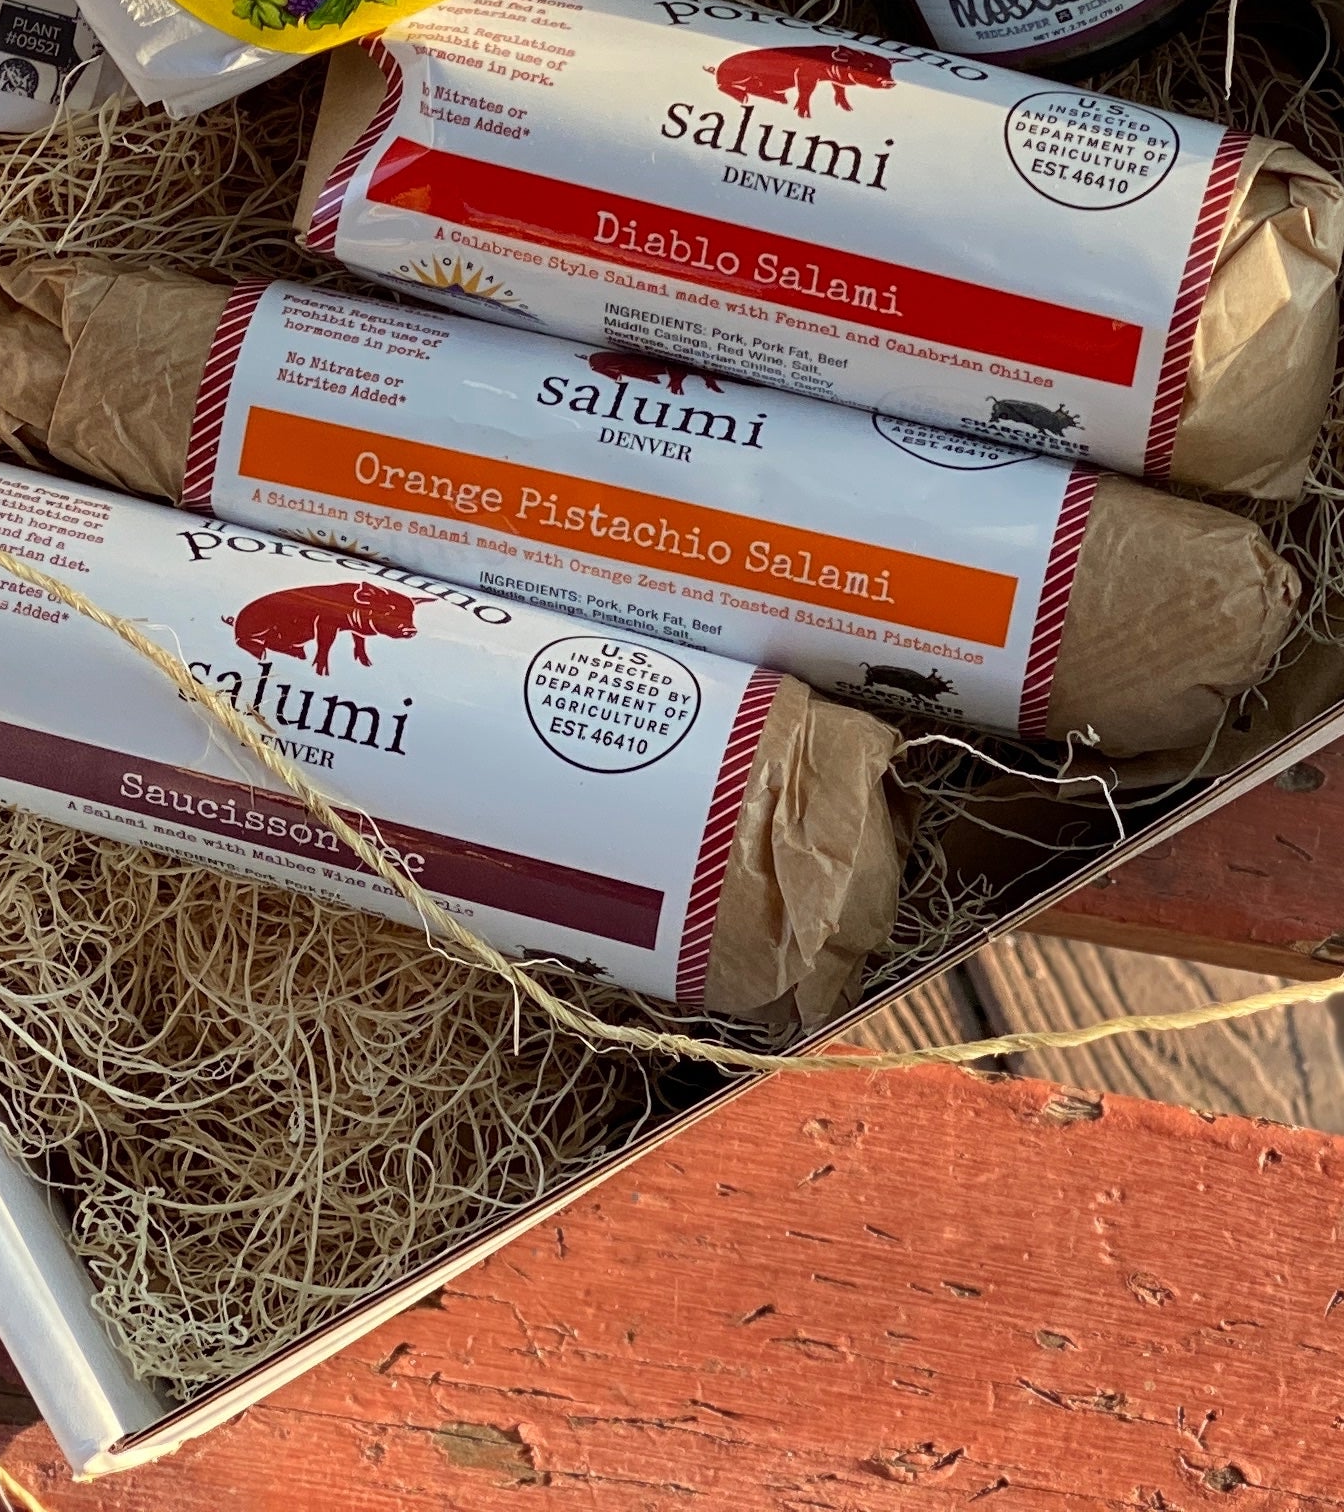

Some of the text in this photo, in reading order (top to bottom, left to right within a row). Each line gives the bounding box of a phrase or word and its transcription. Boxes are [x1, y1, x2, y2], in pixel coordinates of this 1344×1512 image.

[6, 32, 60, 57] #09521
[13, 16, 62, 39] PLANT
[474, 27, 577, 57] Regulations
[407, 32, 542, 65] prohibit the use
[511, 68, 555, 87] pork.
[435, 85, 504, 115] Nitrates
[507, 105, 528, 120] or
[1049, 104, 1151, 132] INSPECTED
[660, 100, 896, 191] salumi
[1015, 121, 1168, 163] DEPARTMENT OF
[1021, 110, 1170, 148] AND PASSED BY
[1022, 138, 1150, 177] AGRICULTURE
[1031, 158, 1129, 194] EST. 46410
[721, 164, 817, 205] DENVER
[593, 210, 904, 318] Diablo Salami
[281, 305, 443, 349] prohibit the use of
[283, 293, 345, 314] Federal
[349, 309, 451, 339] Regulations
[451, 230, 1055, 388] Calabrese Style Salami made with Fennel and Calabrian Chiles
[604, 316, 650, 337] Middle
[284, 317, 431, 361] hormones in pork.
[605, 302, 848, 370] INGREDIENTS: Pork Beef
[276, 368, 347, 395] Nitrites
[285, 351, 405, 389] No Nitrates or
[536, 376, 768, 450] salumi
[598, 427, 693, 463] DENVER
[942, 444, 999, 461] 46410
[45, 499, 110, 521] without
[83, 521, 104, 531] or
[354, 450, 896, 605] Orange Pistachio Salami
[24, 532, 53, 548] fed
[27, 515, 105, 545] hormones
[49, 553, 90, 574] diet.
[267, 492, 348, 522] Sicilian
[353, 509, 403, 533] Style
[407, 521, 471, 546] Salami
[476, 537, 518, 557] made
[522, 546, 564, 568] with
[569, 559, 632, 585] Orange
[637, 574, 677, 594] Zest
[681, 585, 714, 602] and
[720, 591, 791, 620] Toasted
[794, 609, 878, 641] Sicilian
[881, 630, 985, 666] Pistachios
[479, 571, 723, 636] INGREDIENTS: Pork, Pork Beef
[542, 660, 691, 705] AND PASSED BY
[571, 652, 673, 686] INSPECTED
[178, 661, 413, 756] salumi
[535, 674, 689, 721] DEPARTMENT OF
[541, 694, 670, 736] AGRICULTURE
[253, 733, 336, 770] ENVER
[550, 716, 648, 755] EST. 46410
[120, 772, 340, 853] Saucisson
[82, 804, 366, 889] Salami made with Malbec Wine
